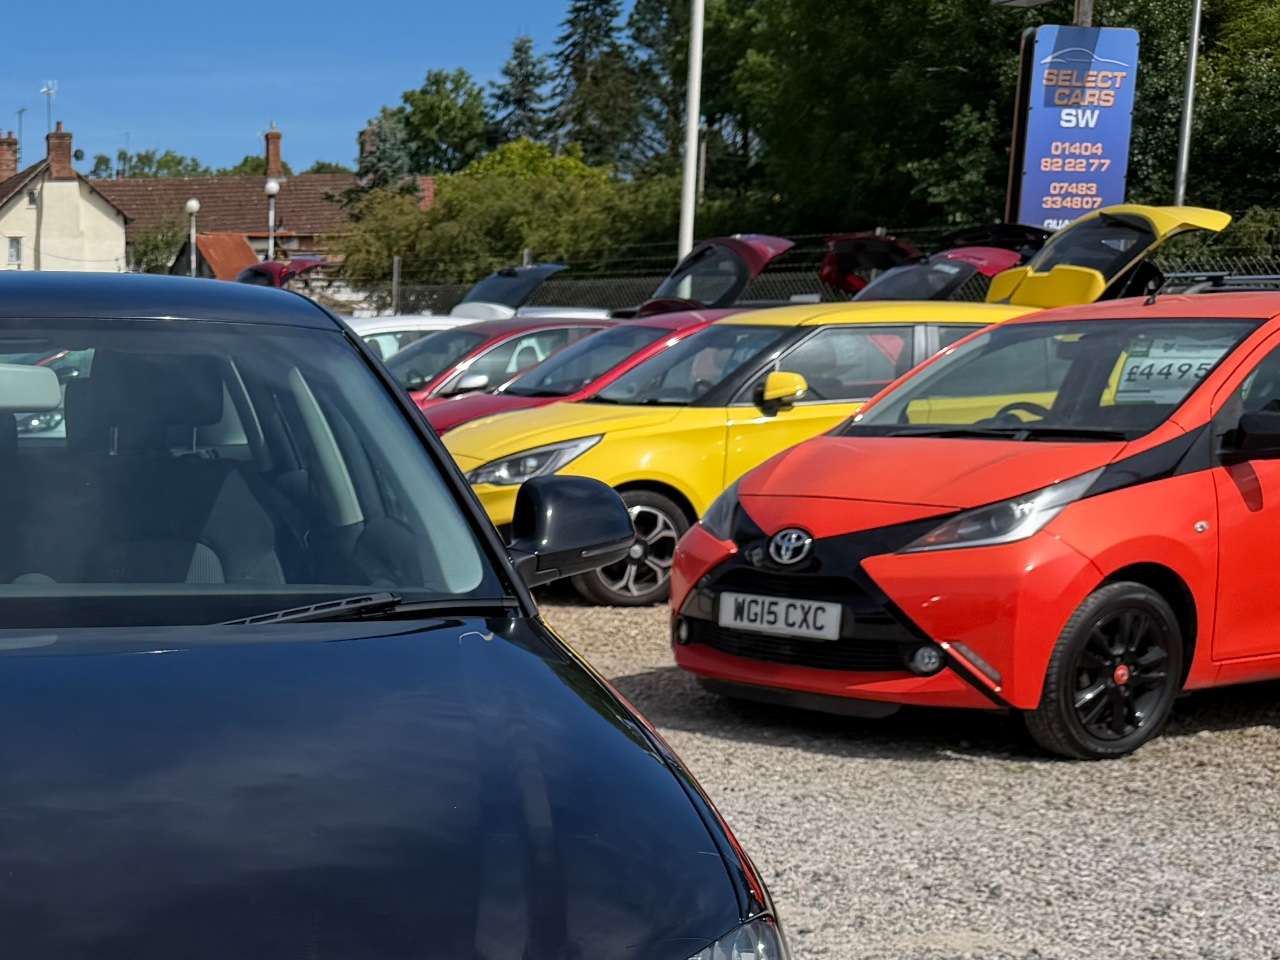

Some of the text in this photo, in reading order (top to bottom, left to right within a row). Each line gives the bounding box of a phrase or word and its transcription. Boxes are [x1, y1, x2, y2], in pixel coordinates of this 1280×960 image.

[1043, 69, 1127, 88] SELECT
[1054, 88, 1115, 107] CARS
[1060, 108, 1099, 128] SW
[1051, 142, 1104, 155] 01404
[1050, 183, 1097, 195] 07483
[1042, 197, 1103, 208] 334807
[1124, 362, 1212, 382] £4495
[734, 597, 826, 631] WG15 CXC
